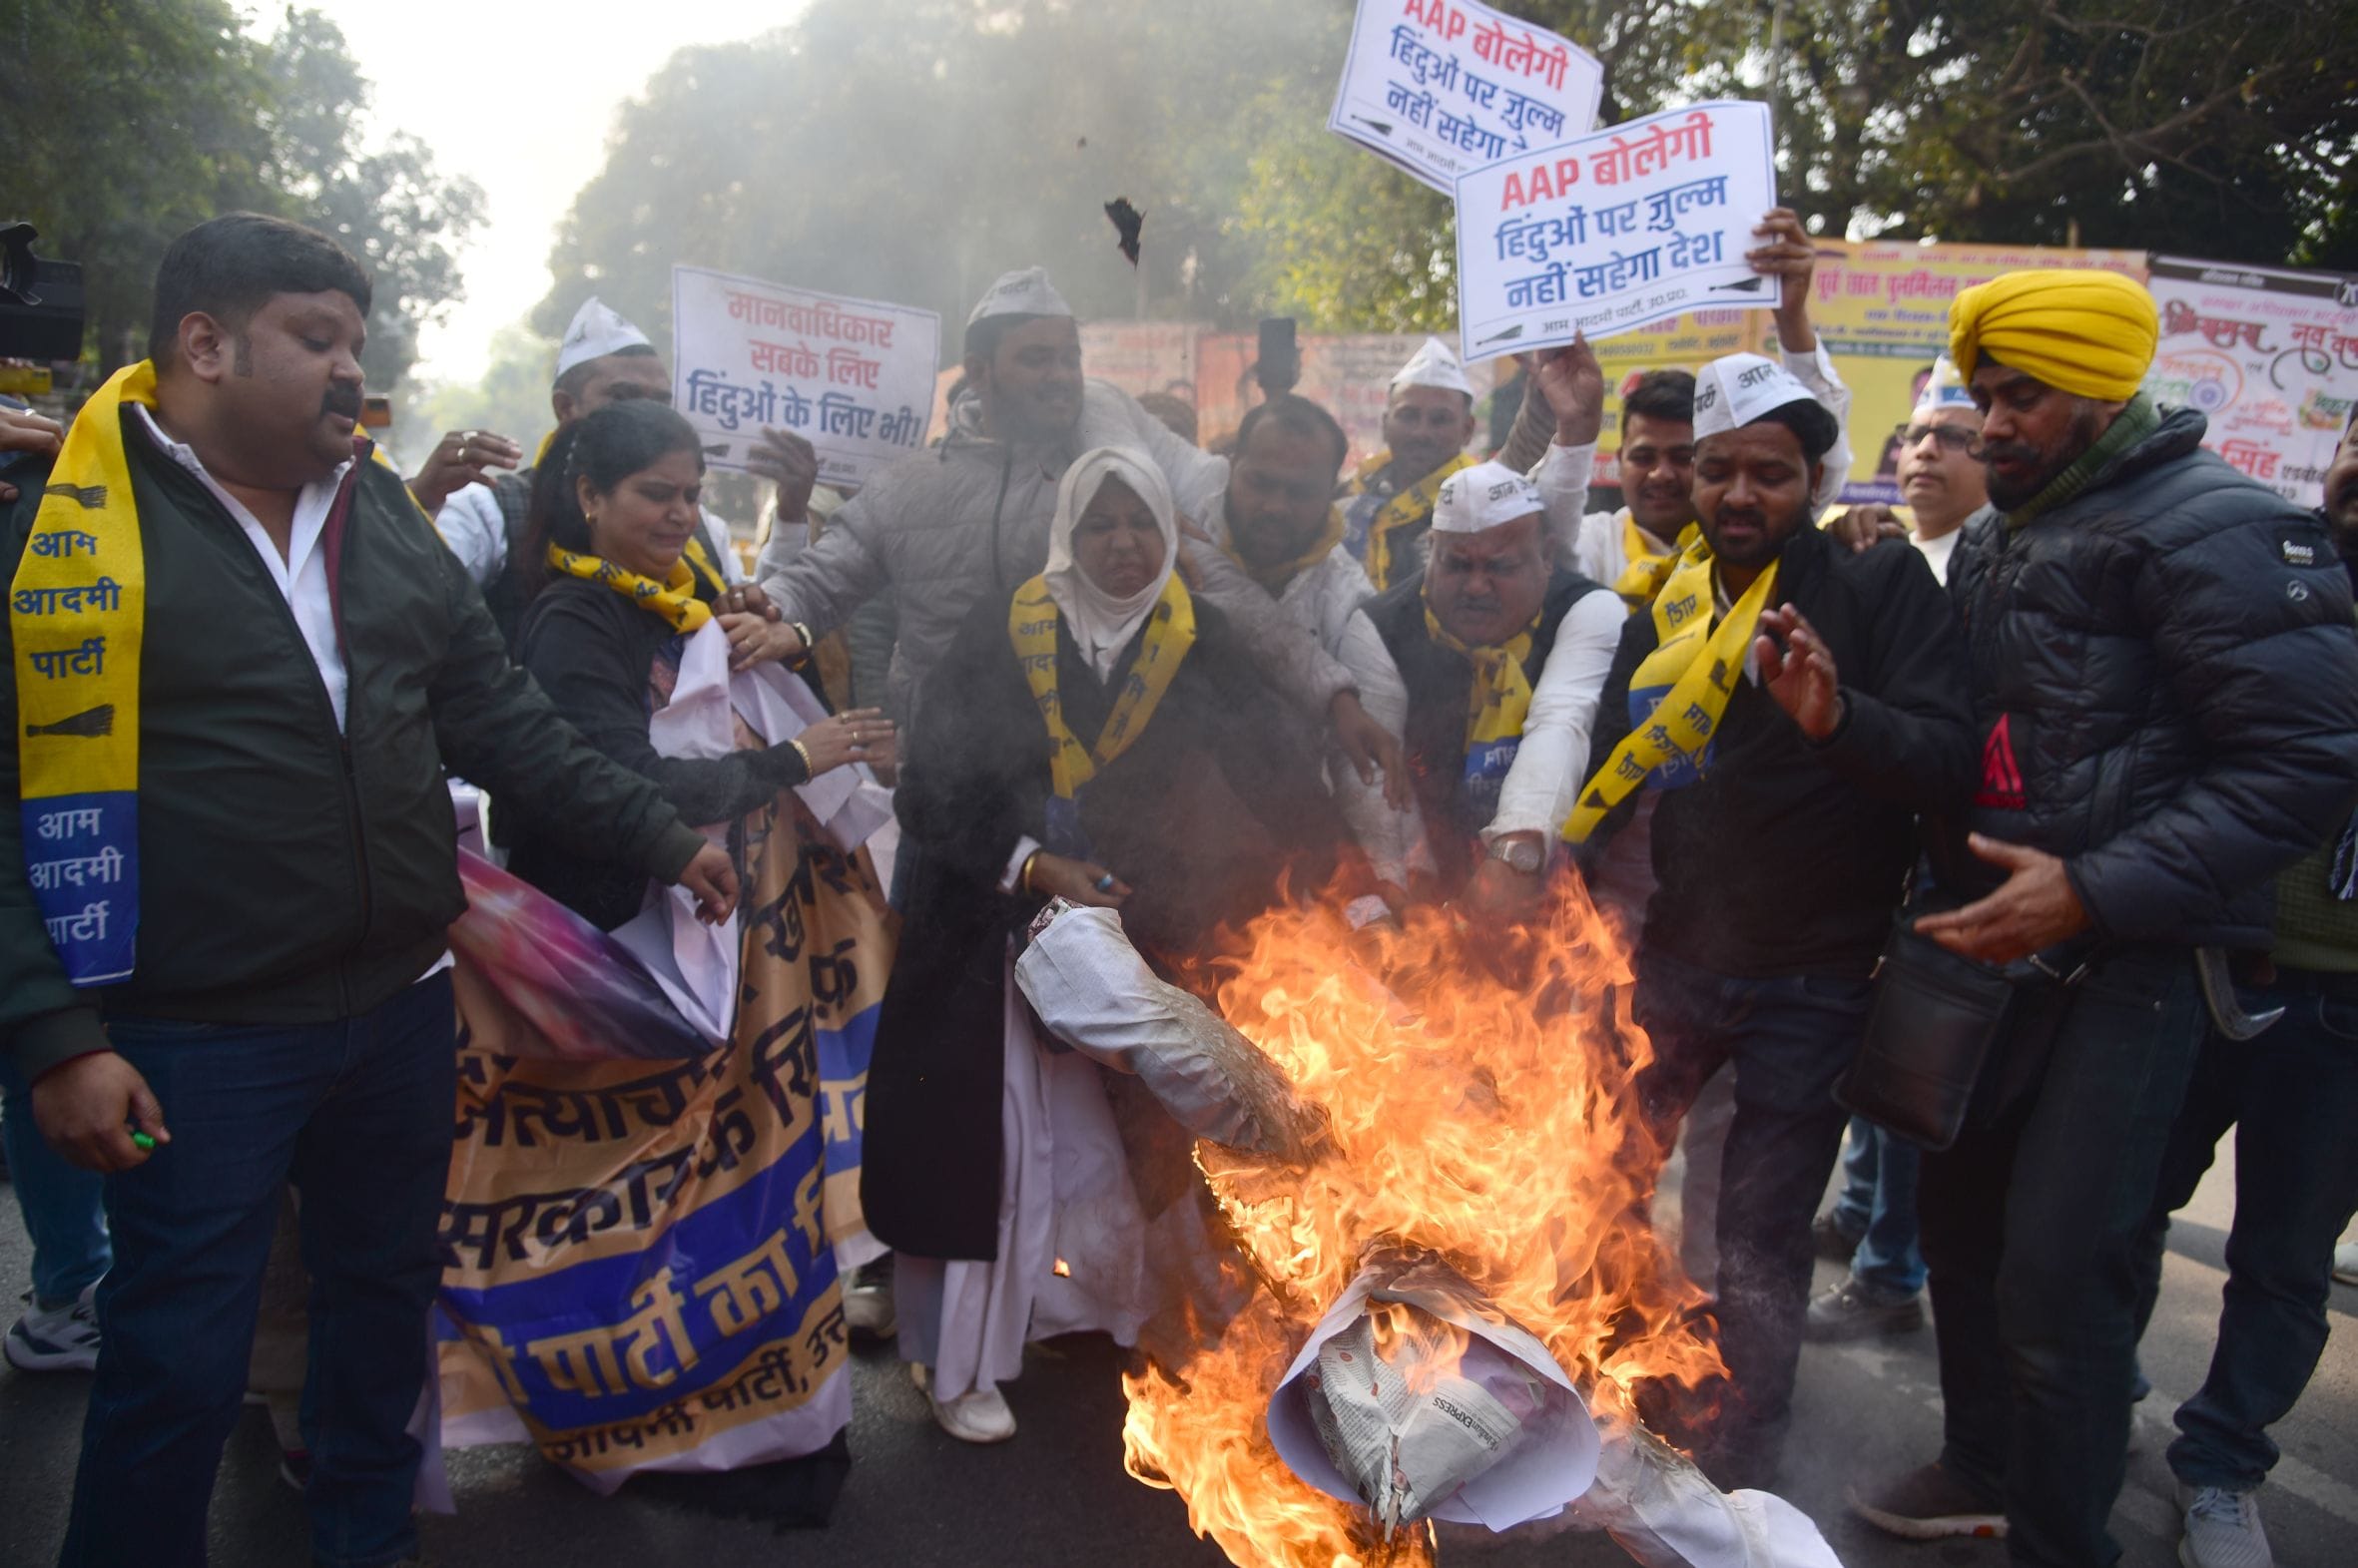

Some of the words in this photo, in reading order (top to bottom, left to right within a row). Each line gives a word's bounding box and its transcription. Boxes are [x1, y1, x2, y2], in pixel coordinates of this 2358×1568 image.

[1390, 25, 1460, 87] हिंदुओं
[1465, 72, 1499, 110] पर
[1403, 0, 1467, 42] AAP
[1473, 18, 1570, 91] बोलेगी
[1387, 81, 1439, 130] नहीं
[1437, 110, 1507, 160] सहेगा
[1500, 157, 1580, 212] AAP
[1589, 112, 1714, 188] बोलेगी
[1494, 205, 1587, 263] हिंदुओं
[1593, 201, 1638, 240] पर
[1503, 261, 1574, 309] नहीं
[1574, 246, 1661, 297] सहेगा
[1666, 231, 1725, 269] देश
[725, 288, 895, 349] मानवाधिकार
[1541, 318, 1569, 334] आम
[748, 339, 821, 379] सबके
[827, 346, 882, 390] लिए
[1737, 362, 1778, 389] आम
[687, 369, 778, 430] हिंदुओं
[782, 385, 814, 429] के
[818, 391, 876, 439] लिए
[879, 406, 921, 448] भी!
[2221, 438, 2282, 479] सिंह
[31, 528, 99, 560] आम
[13, 576, 123, 617] आदमी
[30, 636, 107, 681] पार्टी
[37, 805, 103, 840] आम
[29, 845, 125, 892] आदमी
[526, 1266, 701, 1398] पार्टी
[693, 1228, 799, 1338] का
[1432, 1396, 1474, 1429] EXPRESS
